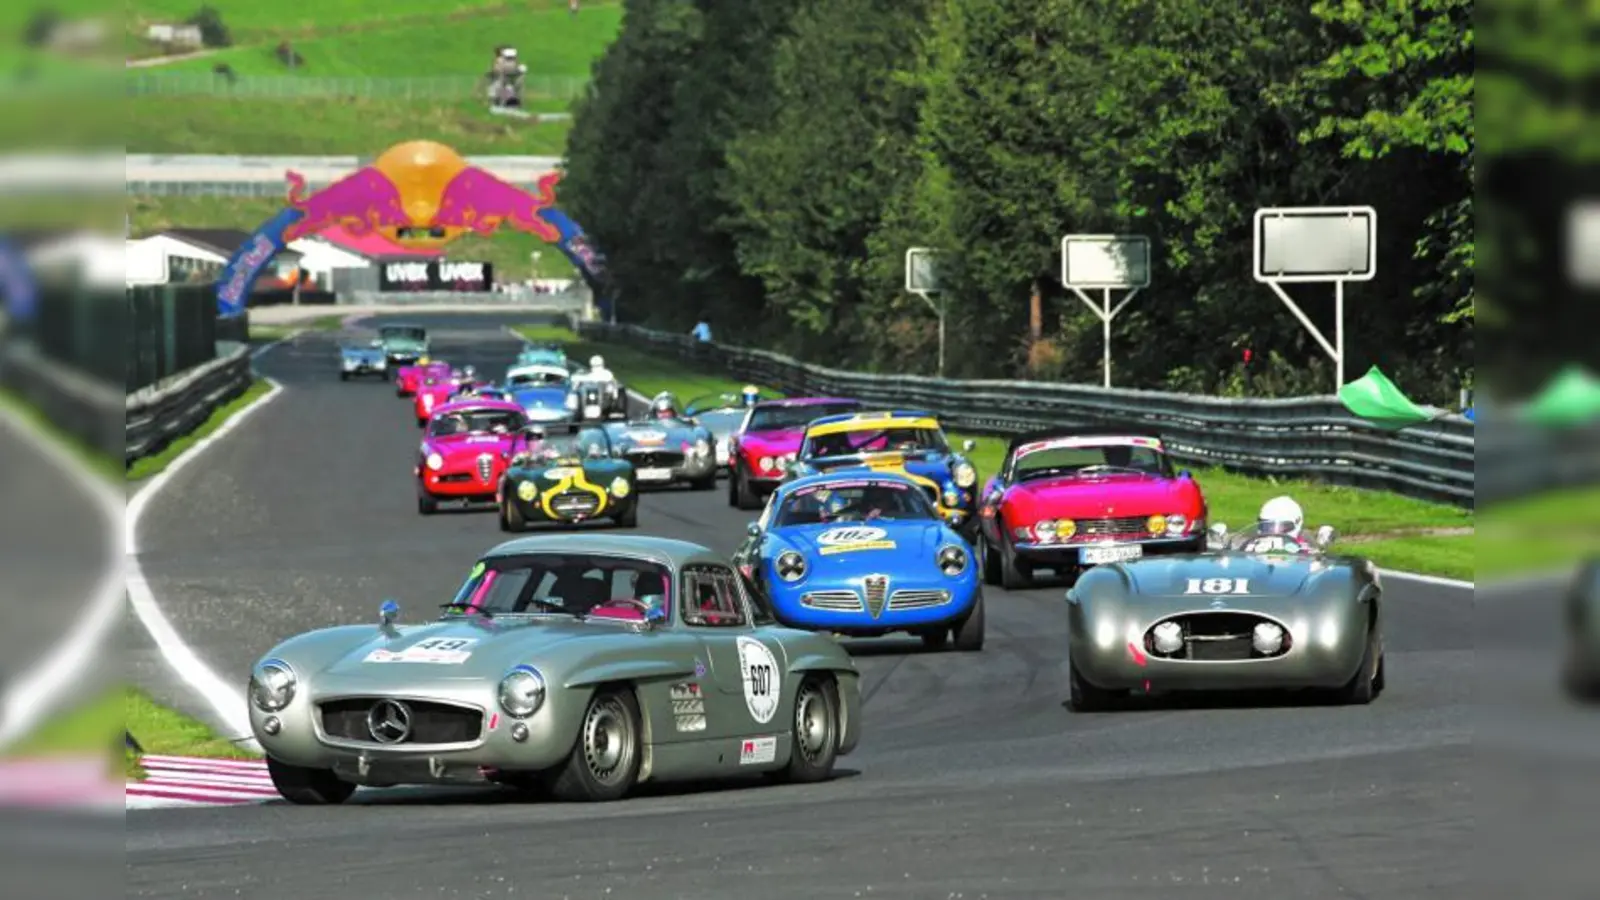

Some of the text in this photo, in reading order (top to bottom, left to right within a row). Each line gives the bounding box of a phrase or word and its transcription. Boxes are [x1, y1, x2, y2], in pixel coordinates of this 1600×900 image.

[1184, 577, 1250, 595] 181
[417, 639, 470, 651] 49
[750, 664, 771, 696] 607
